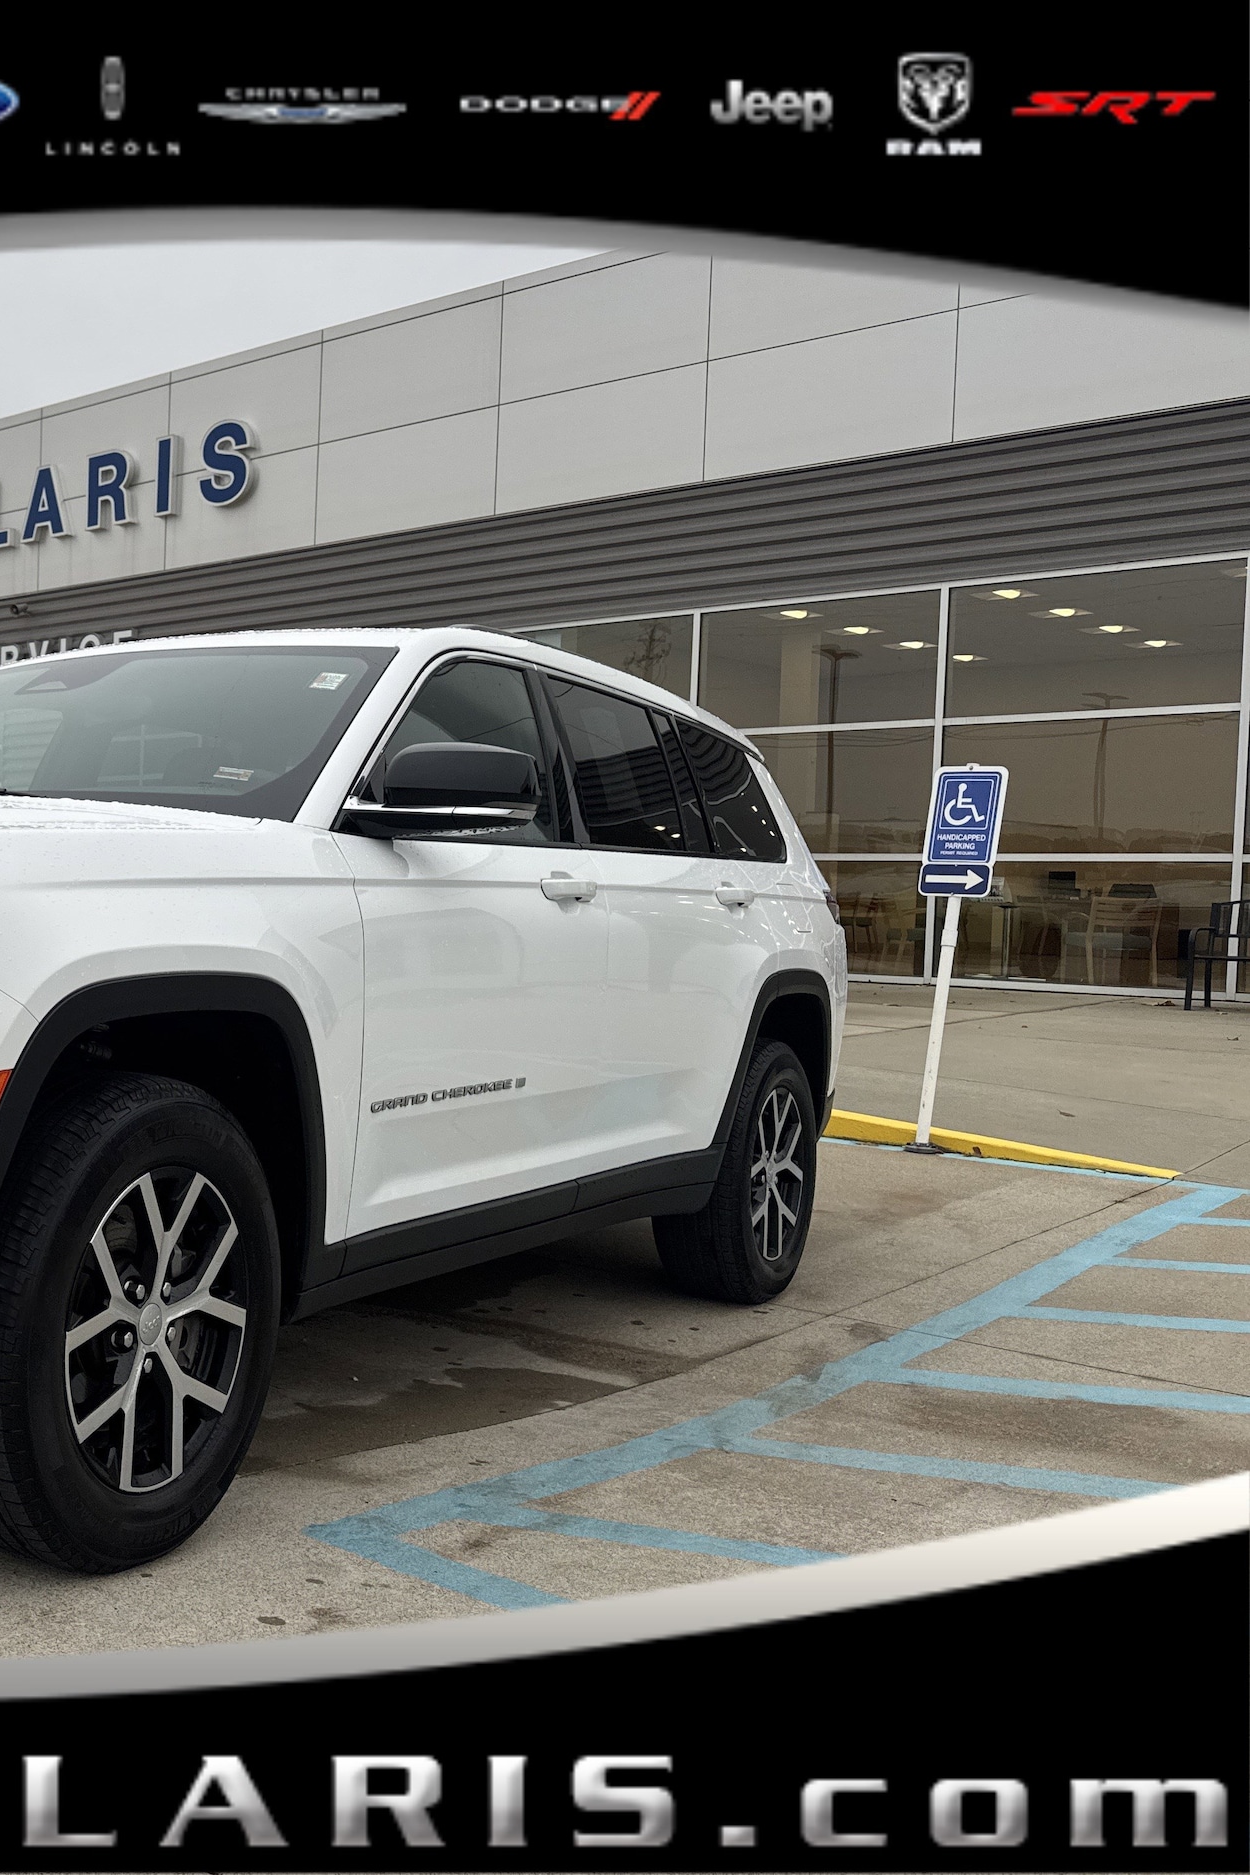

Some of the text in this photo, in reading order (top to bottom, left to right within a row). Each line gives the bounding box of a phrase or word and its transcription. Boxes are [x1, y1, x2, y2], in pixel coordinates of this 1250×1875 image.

[937, 833, 986, 841] HANDICAPPED
[945, 842, 975, 850] PARKING
[370, 1093, 428, 1114] GRAND
[431, 1078, 514, 1102] CHEROKEE
